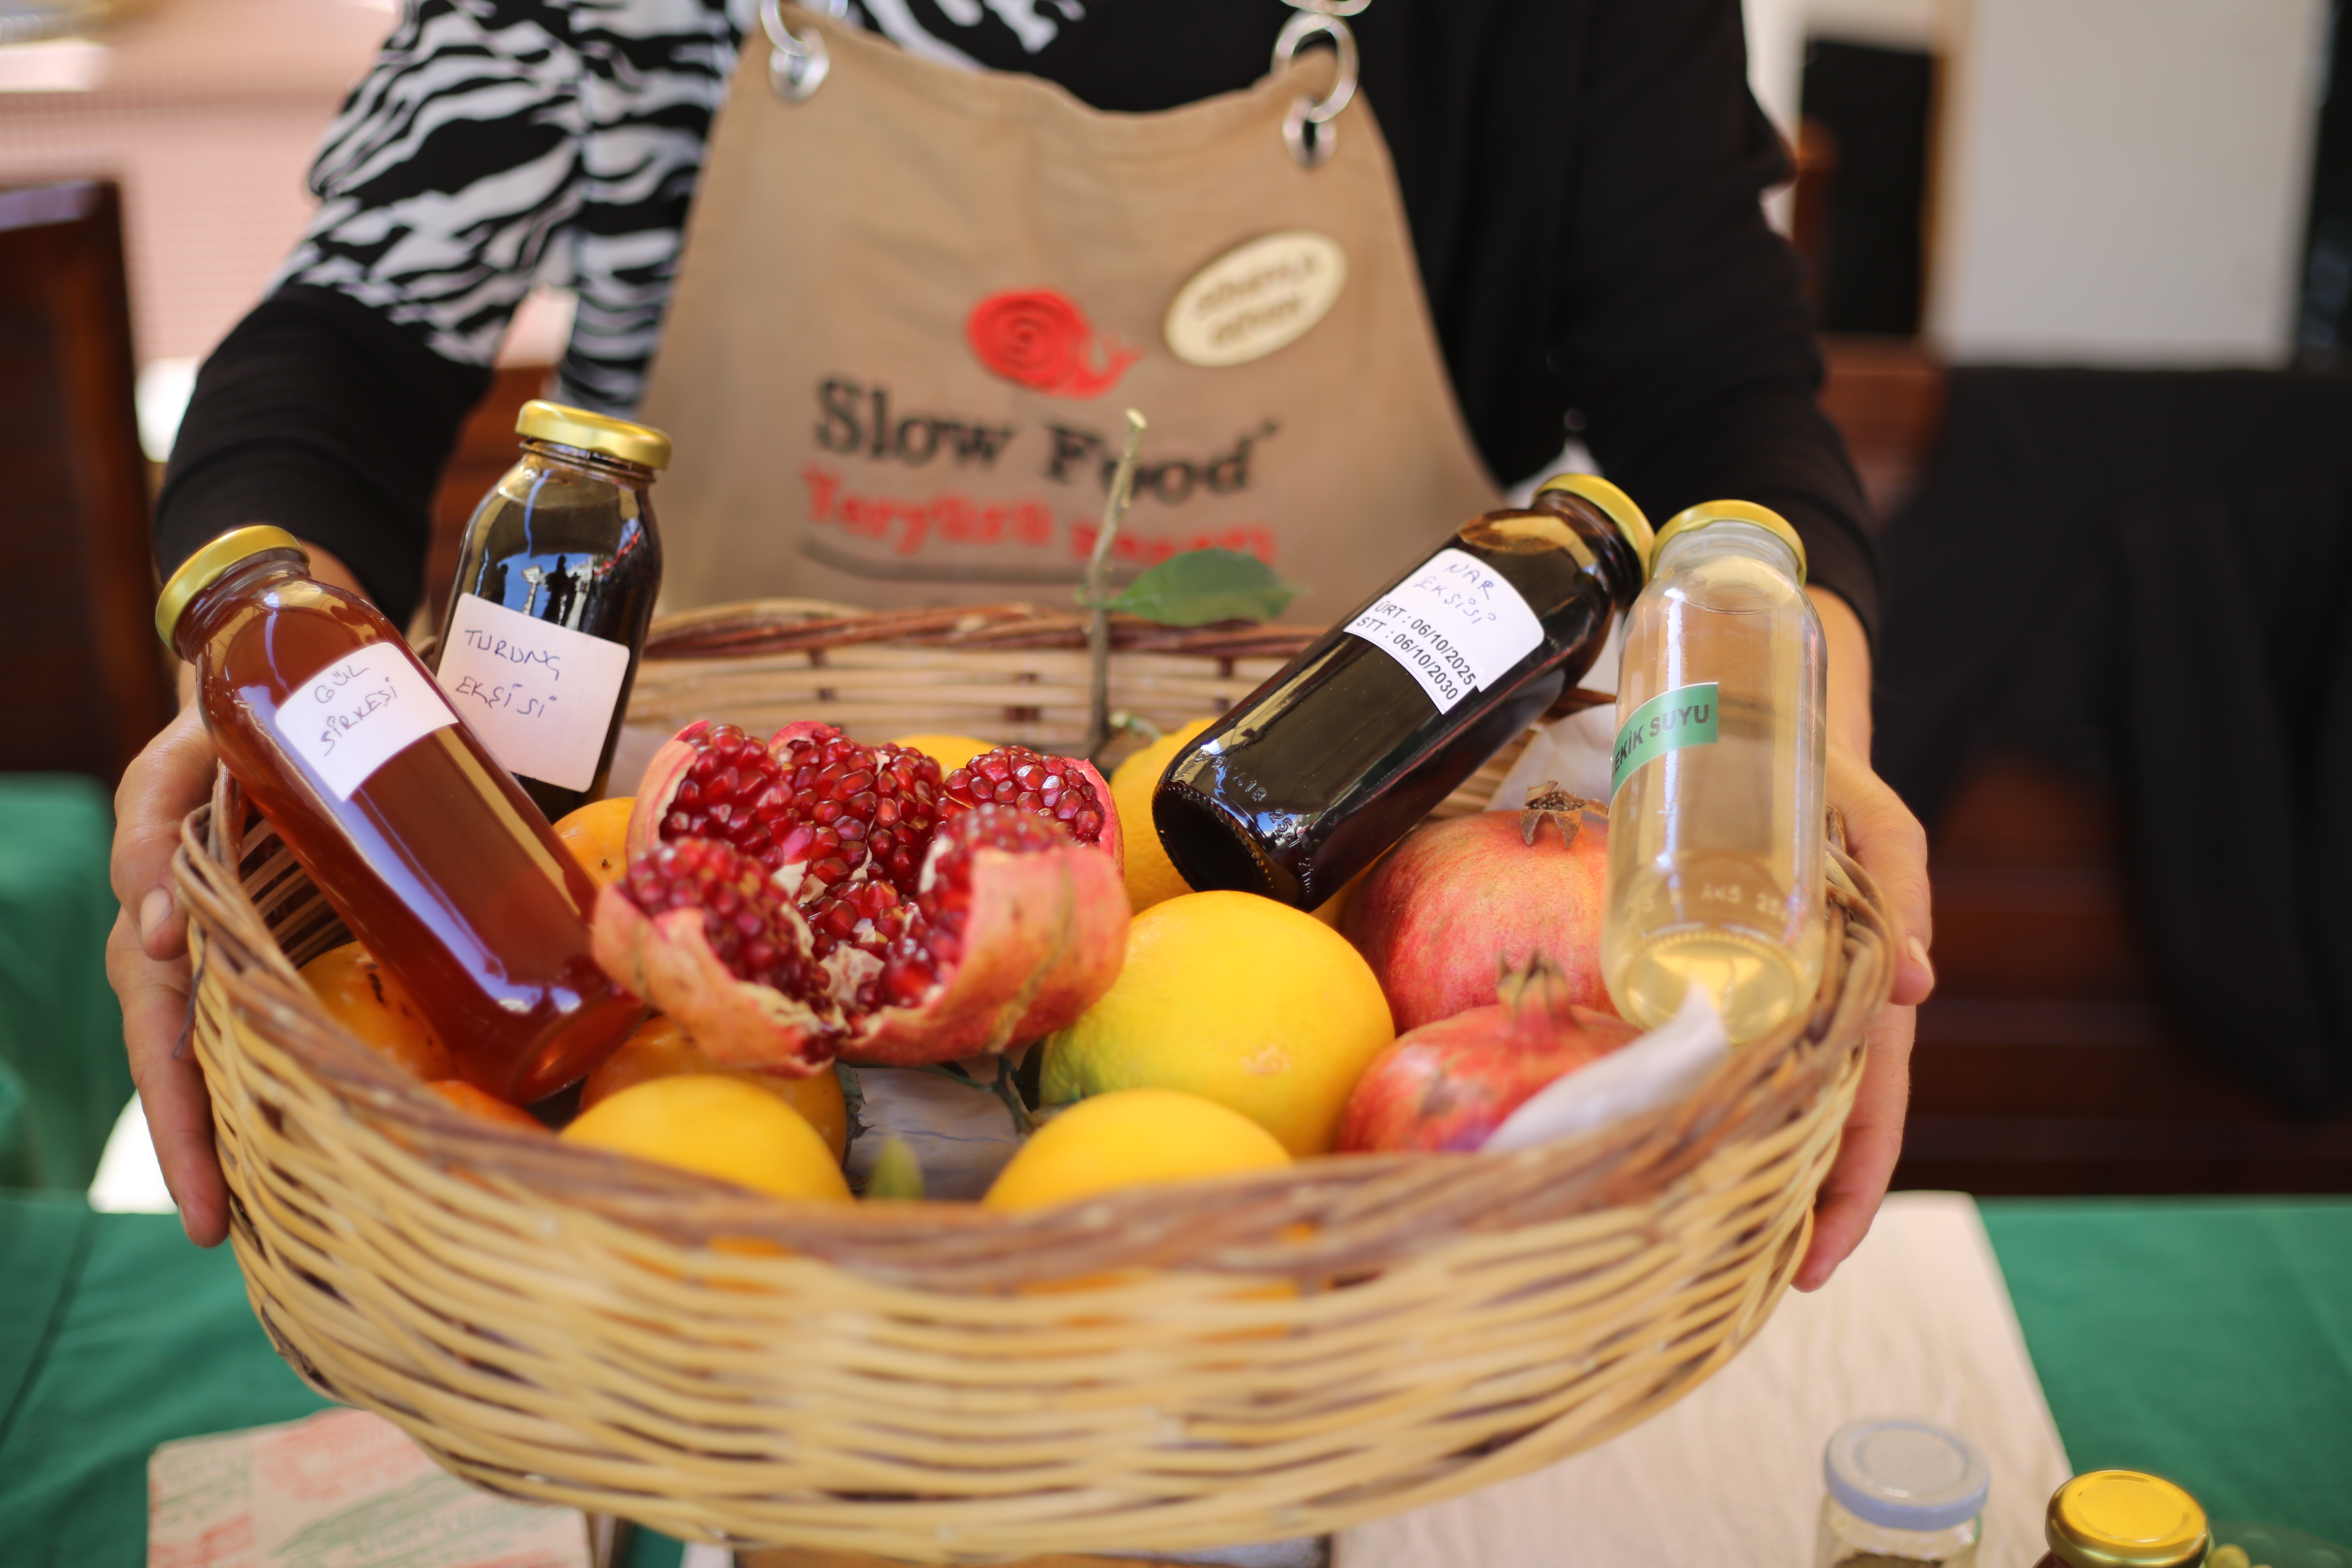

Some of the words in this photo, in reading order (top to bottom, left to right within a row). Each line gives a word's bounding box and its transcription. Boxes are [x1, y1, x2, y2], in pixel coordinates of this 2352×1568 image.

[816, 376, 1016, 469] Slow
[1046, 429, 1254, 506] Food
[1443, 564, 1494, 601] NAR
[464, 630, 561, 682] TURUNÇ
[1356, 617, 1387, 632] STT
[1392, 633, 1458, 700] 06/10/2030
[1374, 601, 1407, 619] ÜRT
[1410, 619, 1477, 686] 06/10/2025
[314, 665, 370, 704] GÜL
[1648, 704, 1709, 737] SUYU
